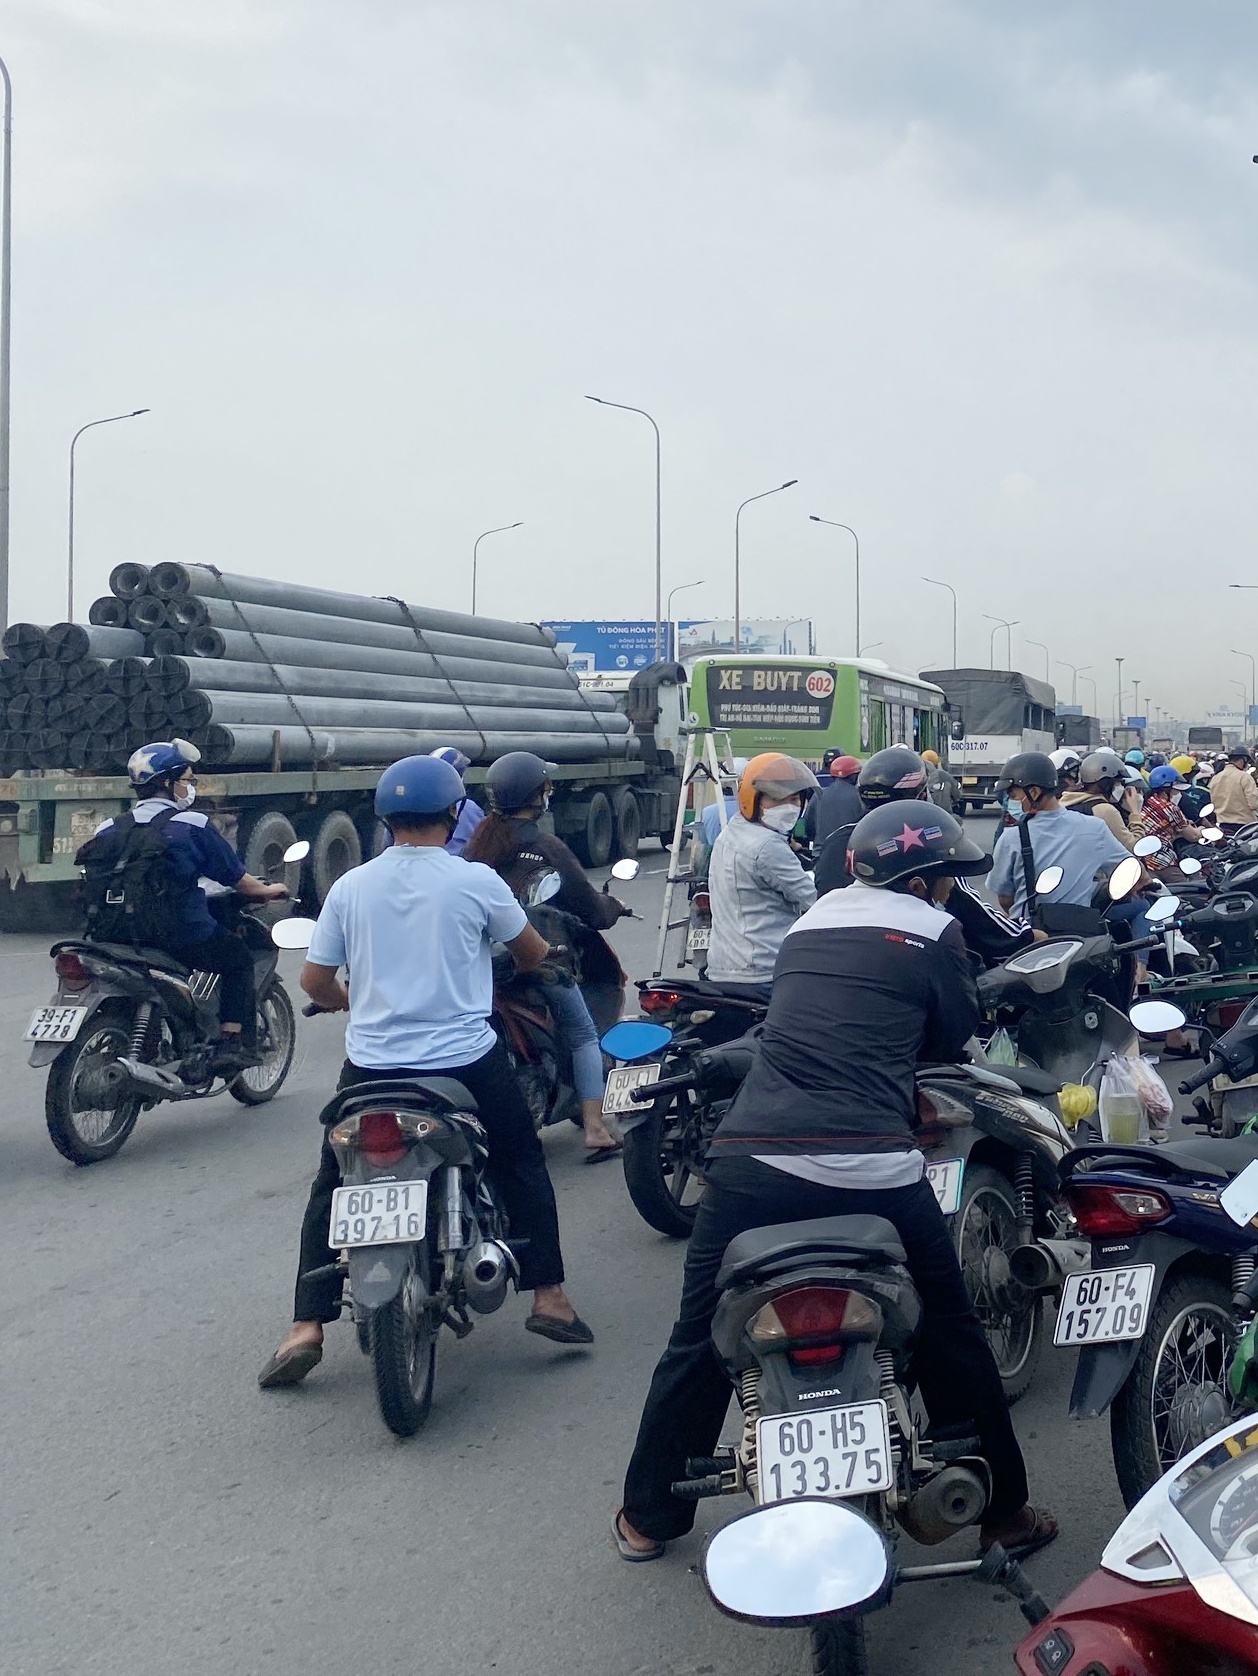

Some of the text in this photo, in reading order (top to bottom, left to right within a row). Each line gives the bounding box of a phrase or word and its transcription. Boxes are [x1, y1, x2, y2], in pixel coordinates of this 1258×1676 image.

[597, 626, 606, 634] TỦ
[607, 626, 630, 634] ĐÔNG
[630, 626, 647, 634] HÒA
[719, 670, 832, 692] XE BUYT 602
[904, 938, 925, 949] sports
[37, 1009, 77, 1023] 39-F1
[30, 1023, 71, 1038] 4728
[347, 1187, 410, 1215] 60-B1
[337, 1213, 419, 1243] 397.16
[1102, 1244, 1130, 1253] HONDA
[1076, 1271, 1137, 1306] 60-F4
[1064, 1303, 1142, 1341] 157.09
[798, 1389, 841, 1400] HONDA
[778, 1411, 866, 1456] 60-H5
[769, 1448, 882, 1499] 133.75
